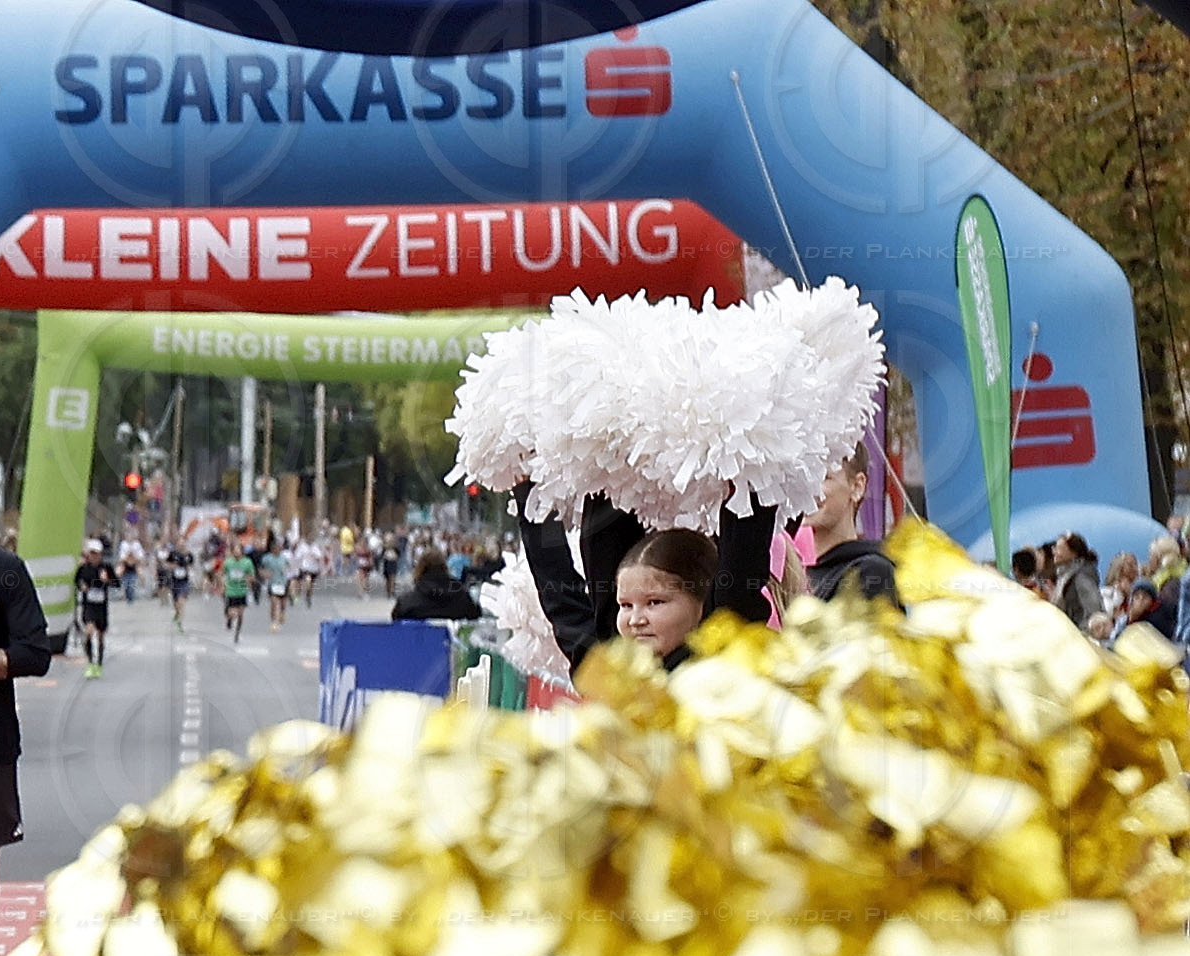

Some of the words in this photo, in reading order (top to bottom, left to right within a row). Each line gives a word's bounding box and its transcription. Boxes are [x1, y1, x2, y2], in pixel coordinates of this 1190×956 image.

[54, 47, 567, 125] SPARKASSE
[346, 199, 679, 279] ZEITUNG
[152, 324, 290, 360] ENERGIE
[303, 335, 486, 364] STEIERMAR
